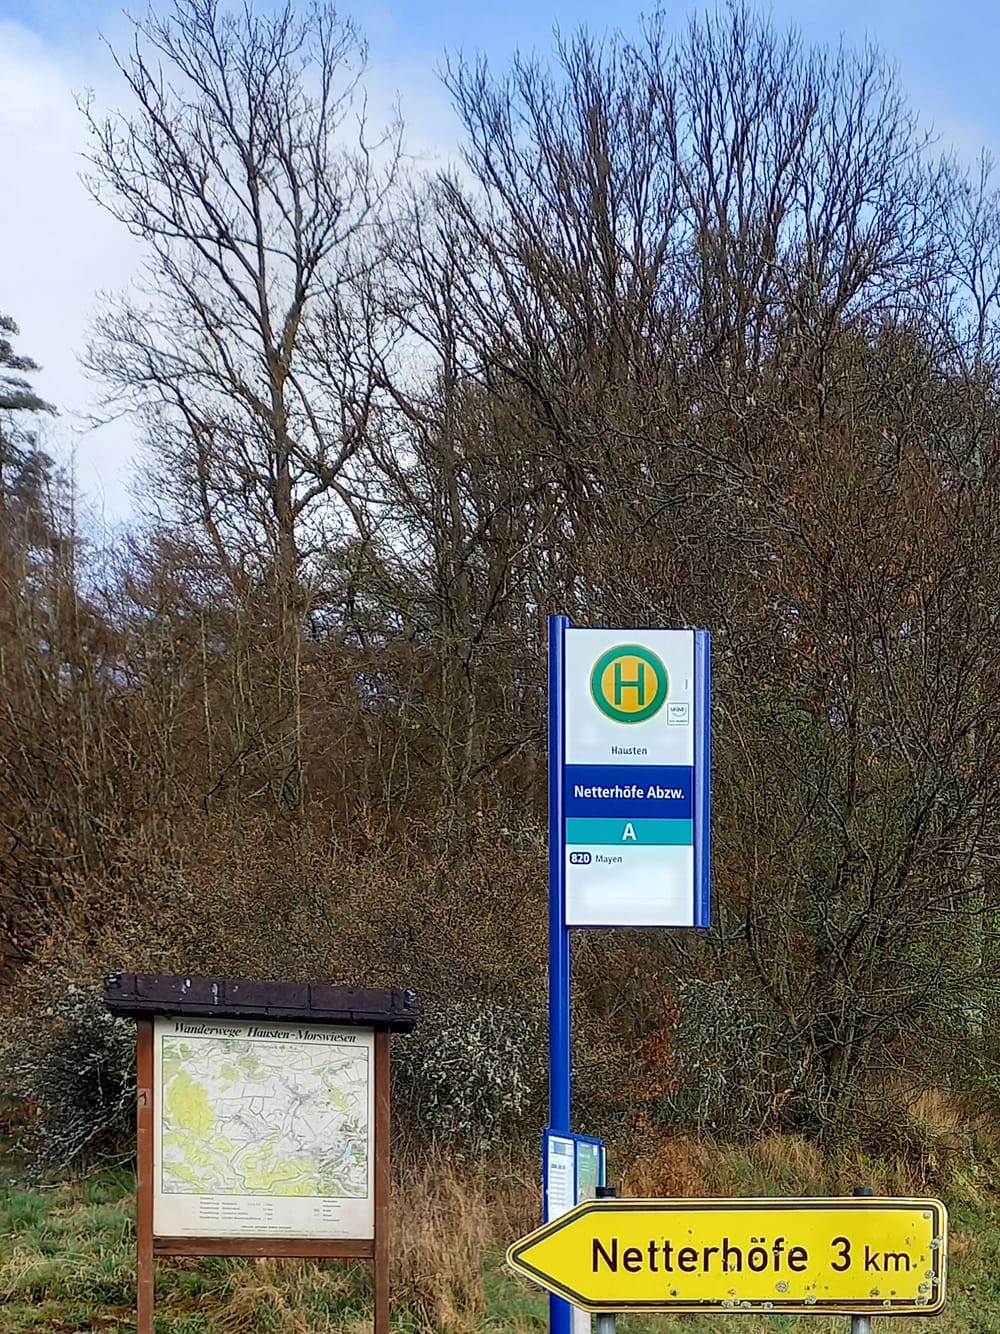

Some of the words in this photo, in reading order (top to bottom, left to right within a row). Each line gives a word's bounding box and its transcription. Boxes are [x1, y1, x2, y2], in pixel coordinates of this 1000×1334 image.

[614, 662, 645, 706] H
[611, 745, 648, 755] Hausten
[574, 784, 644, 799] Netterhöfe
[646, 785, 685, 799] Abzw.
[622, 822, 637, 841] A
[571, 853, 591, 864] 820
[595, 855, 623, 865] Mayen
[174, 1022, 242, 1038] Wanderwege
[247, 1026, 357, 1043] Hausten-Morswiesen
[591, 1237, 809, 1273] Netterhöfe
[830, 1236, 852, 1272] 3
[863, 1245, 911, 1272] km
